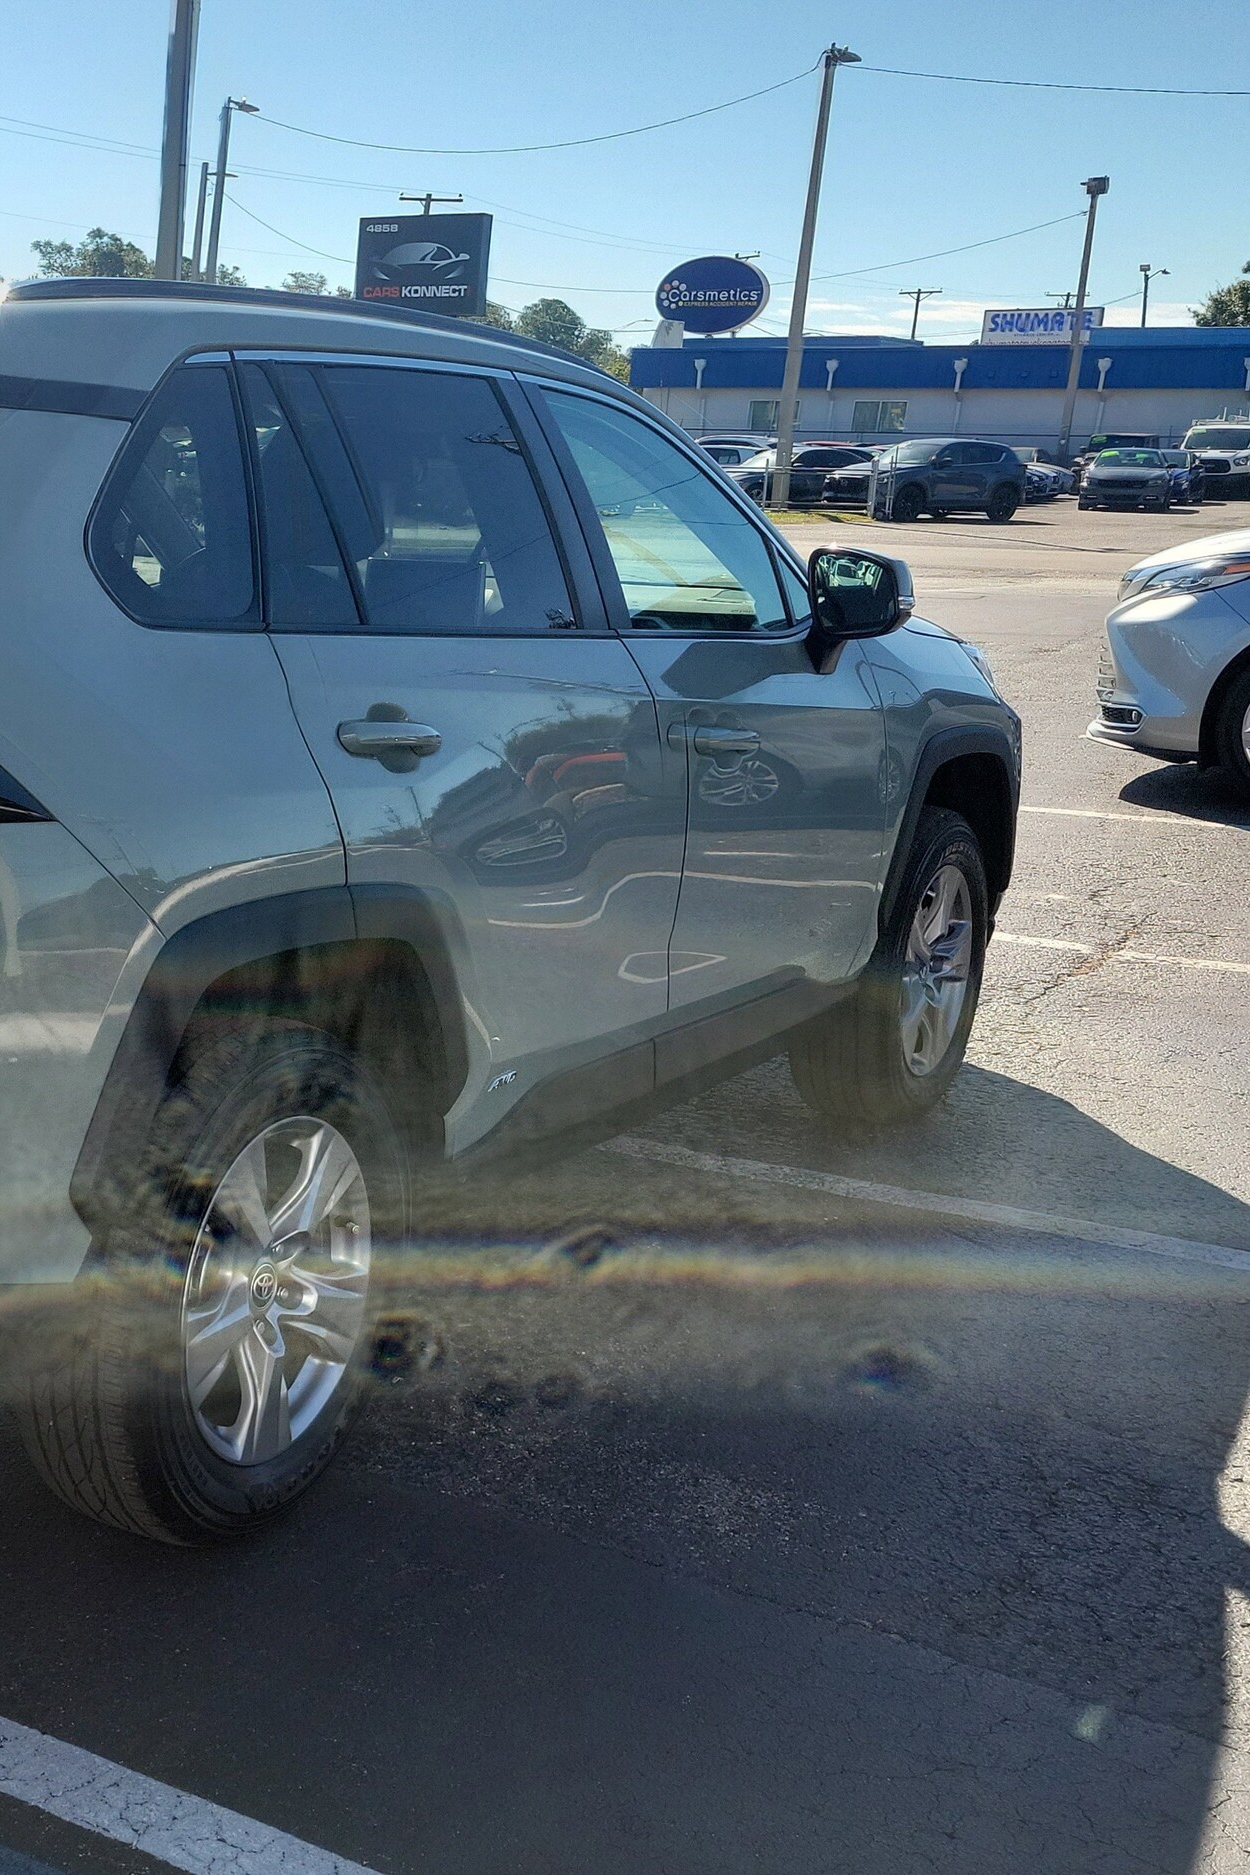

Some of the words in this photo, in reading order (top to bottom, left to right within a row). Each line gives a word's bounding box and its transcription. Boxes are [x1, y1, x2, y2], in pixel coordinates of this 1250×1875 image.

[363, 286, 399, 298] CARS
[401, 285, 468, 298] KONNECT
[668, 288, 758, 302] Carsmetics
[988, 311, 1093, 333] SHUMATE
